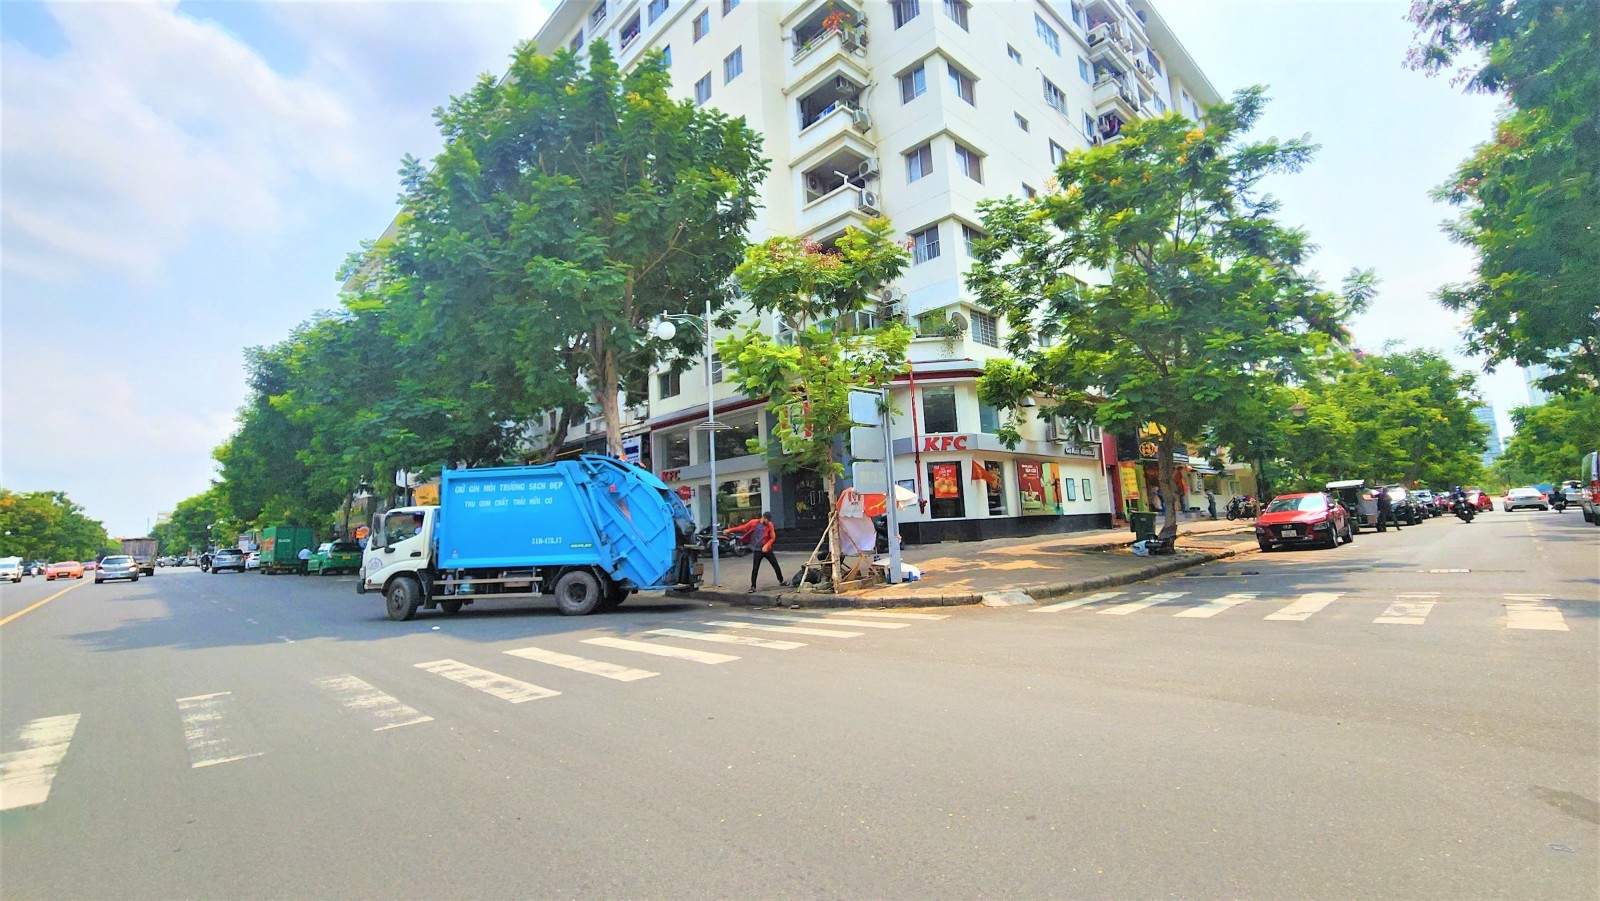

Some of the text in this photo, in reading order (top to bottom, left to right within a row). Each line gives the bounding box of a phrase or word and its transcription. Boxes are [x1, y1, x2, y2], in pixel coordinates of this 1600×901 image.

[924, 435, 967, 451] KFC
[661, 470, 680, 480] KFC
[529, 482, 546, 492] SẠCH
